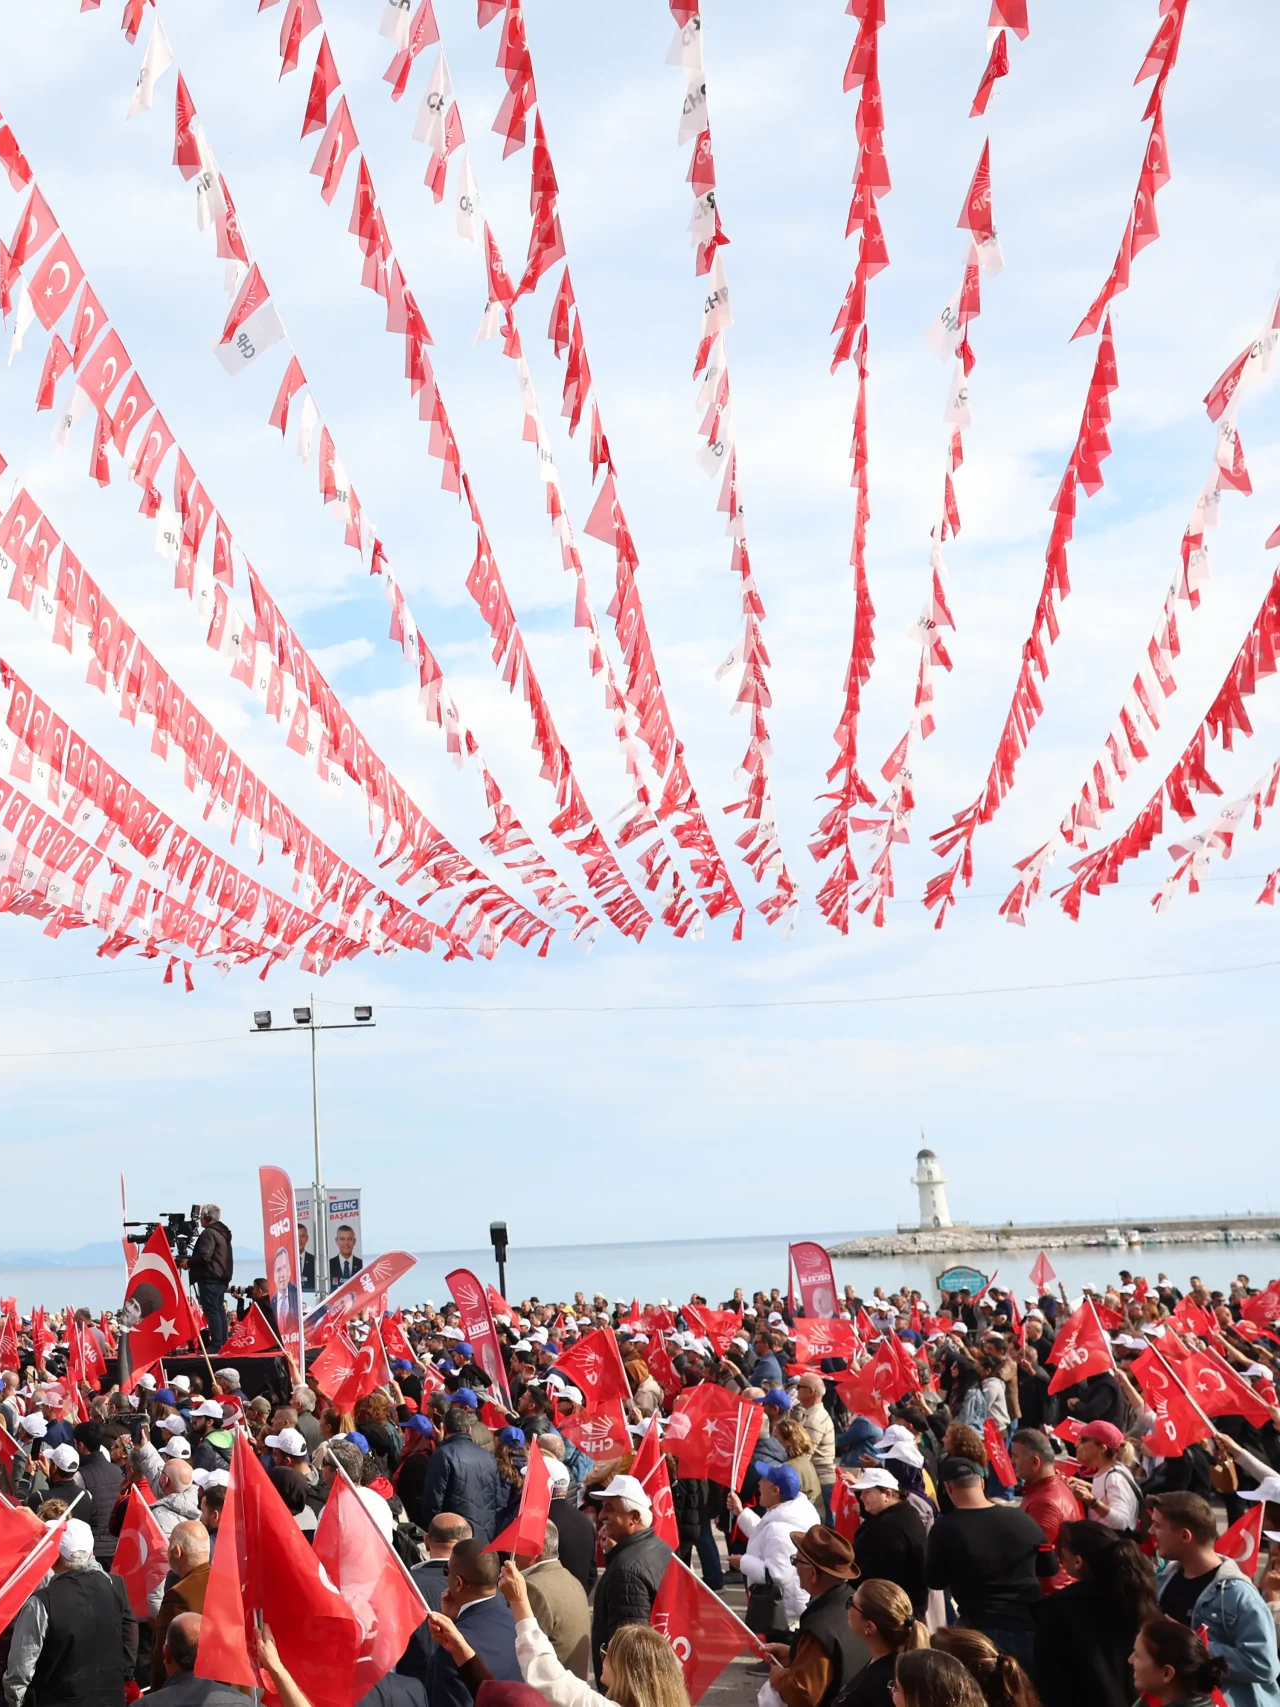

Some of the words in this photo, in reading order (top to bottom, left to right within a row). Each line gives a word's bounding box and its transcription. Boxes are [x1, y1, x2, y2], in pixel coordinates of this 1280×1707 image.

[941, 306, 961, 332] CHP
[331, 1201, 357, 1212] GENÇ
[329, 1211, 360, 1221] BAŞKAN
[360, 1273, 376, 1294] CHP
